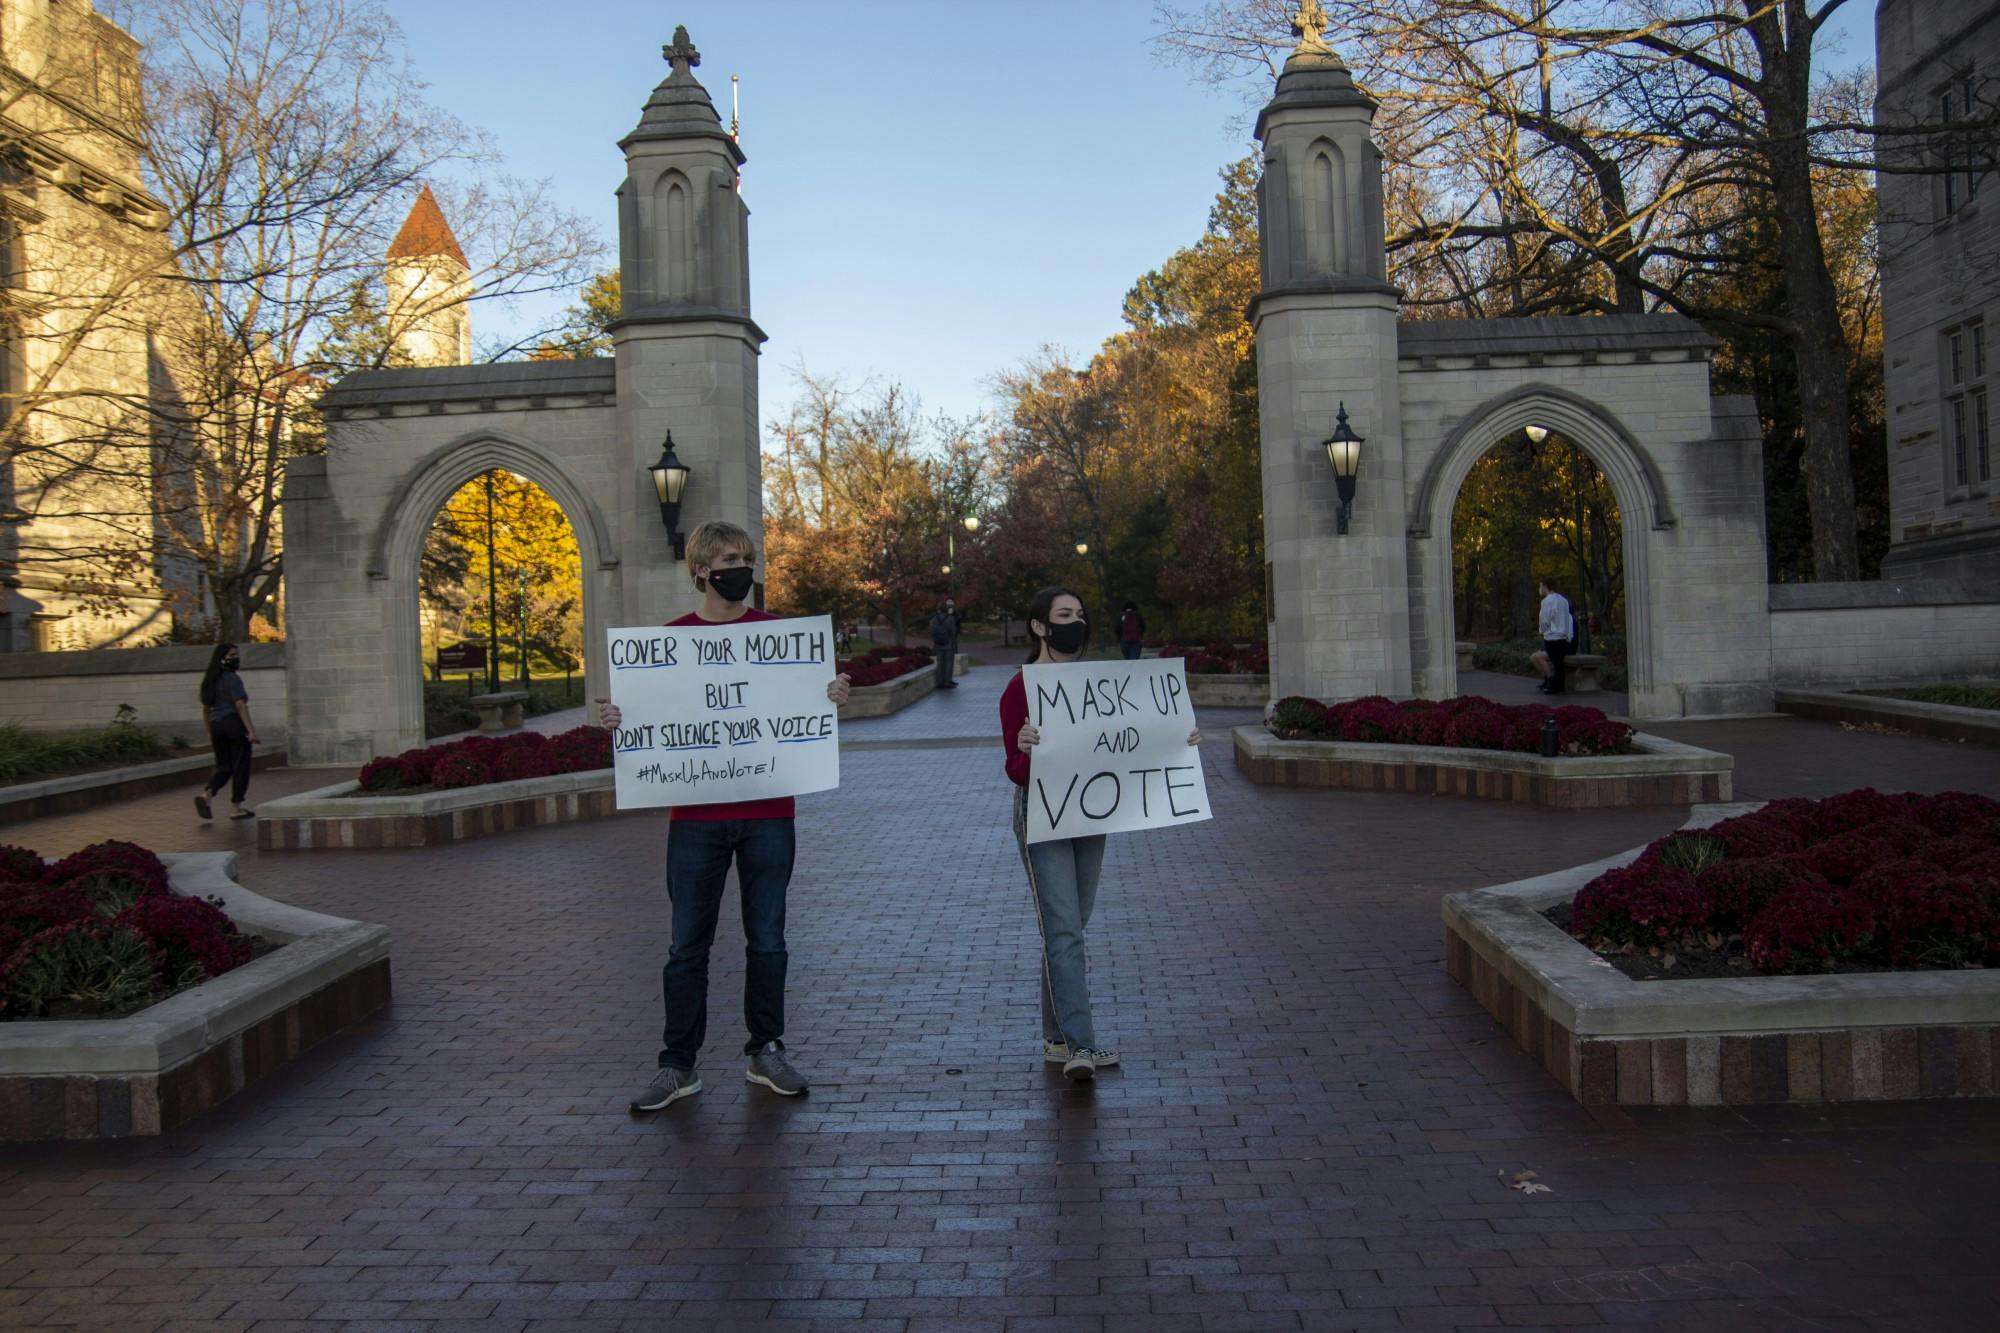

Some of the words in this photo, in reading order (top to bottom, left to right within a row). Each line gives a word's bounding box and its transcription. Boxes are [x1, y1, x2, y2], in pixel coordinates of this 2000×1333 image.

[611, 636, 677, 665] COVER
[692, 638, 736, 664] YOUR
[745, 632, 825, 662] MOUTH
[705, 682, 749, 708] BUT
[1037, 675, 1139, 726] MASK
[1150, 673, 1181, 715] UP
[660, 721, 720, 747] SILENCE
[722, 718, 762, 742] YOUR
[767, 714, 833, 738] VOICE
[1093, 727, 1140, 753] AND
[1037, 766, 1200, 830] VOTE
